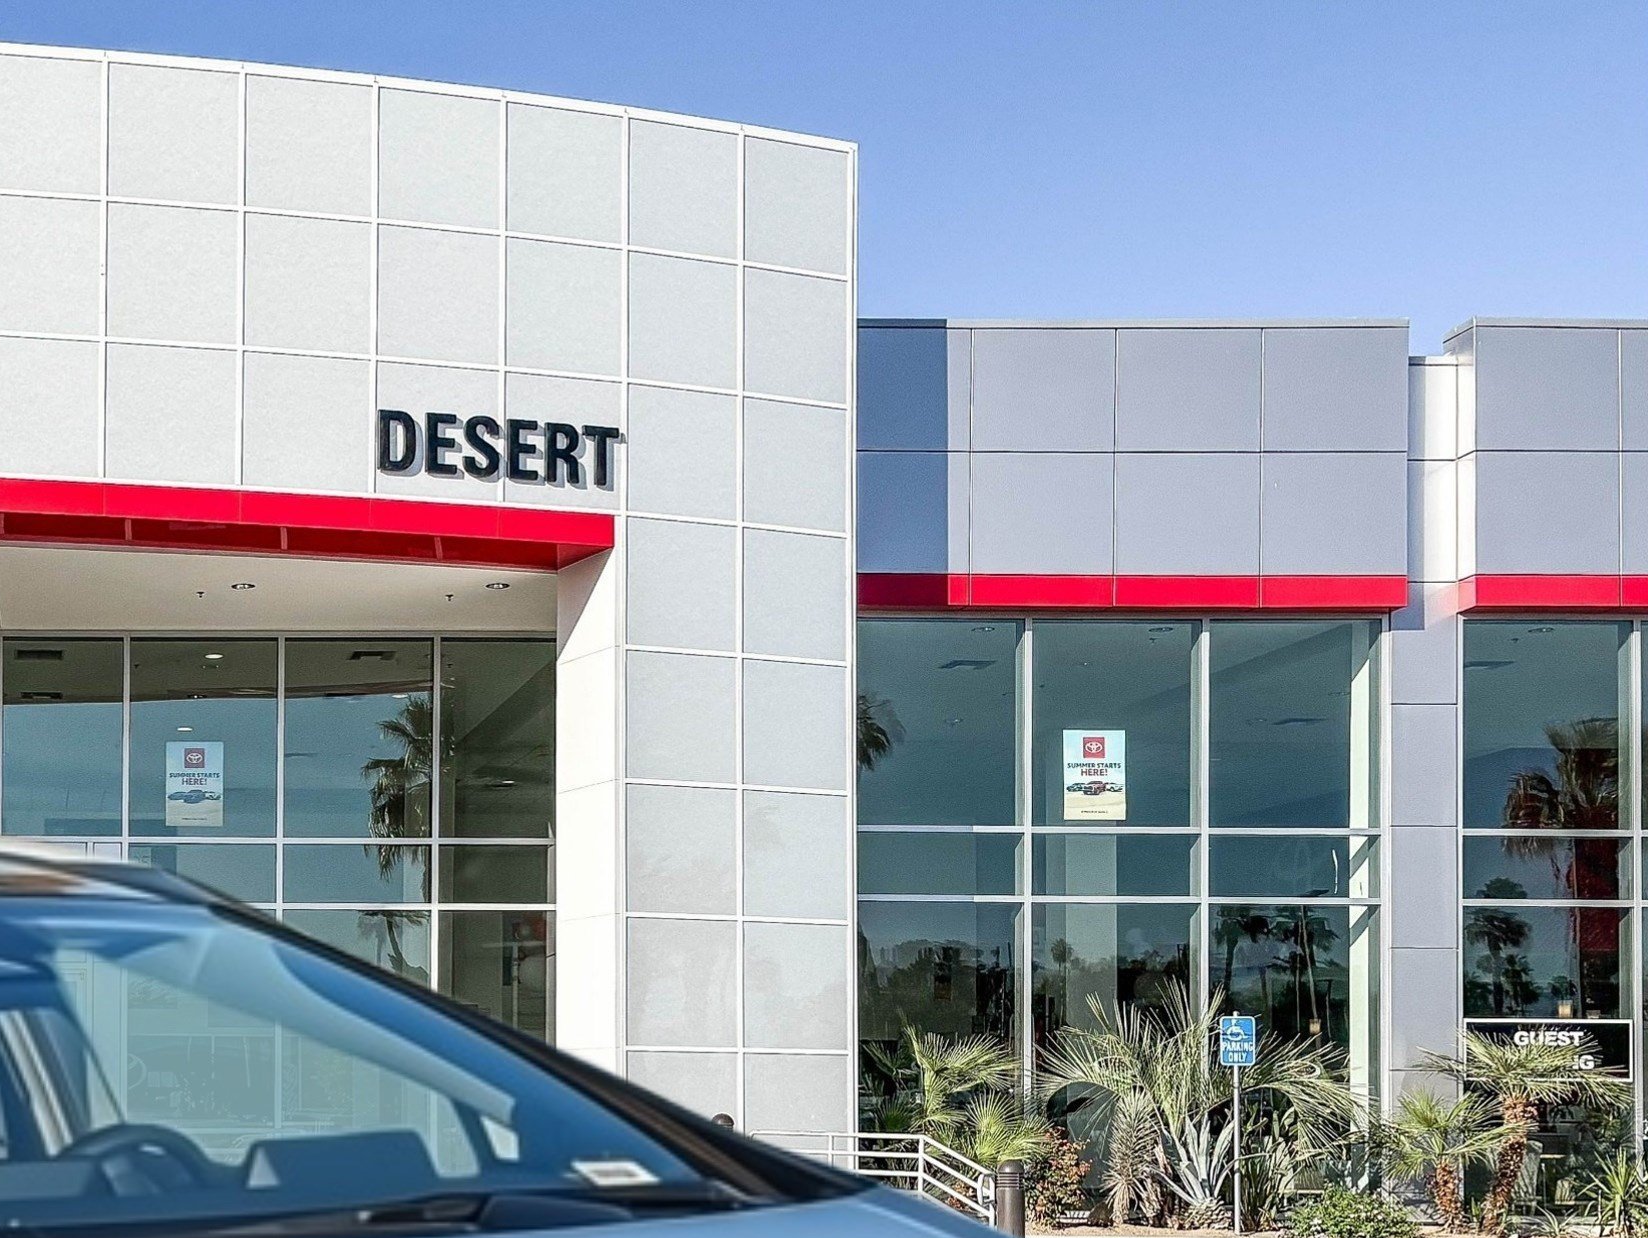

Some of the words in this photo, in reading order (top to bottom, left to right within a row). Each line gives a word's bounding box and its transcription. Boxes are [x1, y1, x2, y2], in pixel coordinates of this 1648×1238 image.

[377, 409, 620, 487] DESERT
[1081, 768, 1108, 777] HERE!
[182, 778, 207, 786] HERE!
[1513, 1030, 1584, 1047] GUEST
[1222, 1040, 1254, 1052] PARKING
[1228, 1051, 1248, 1063] ONLY
